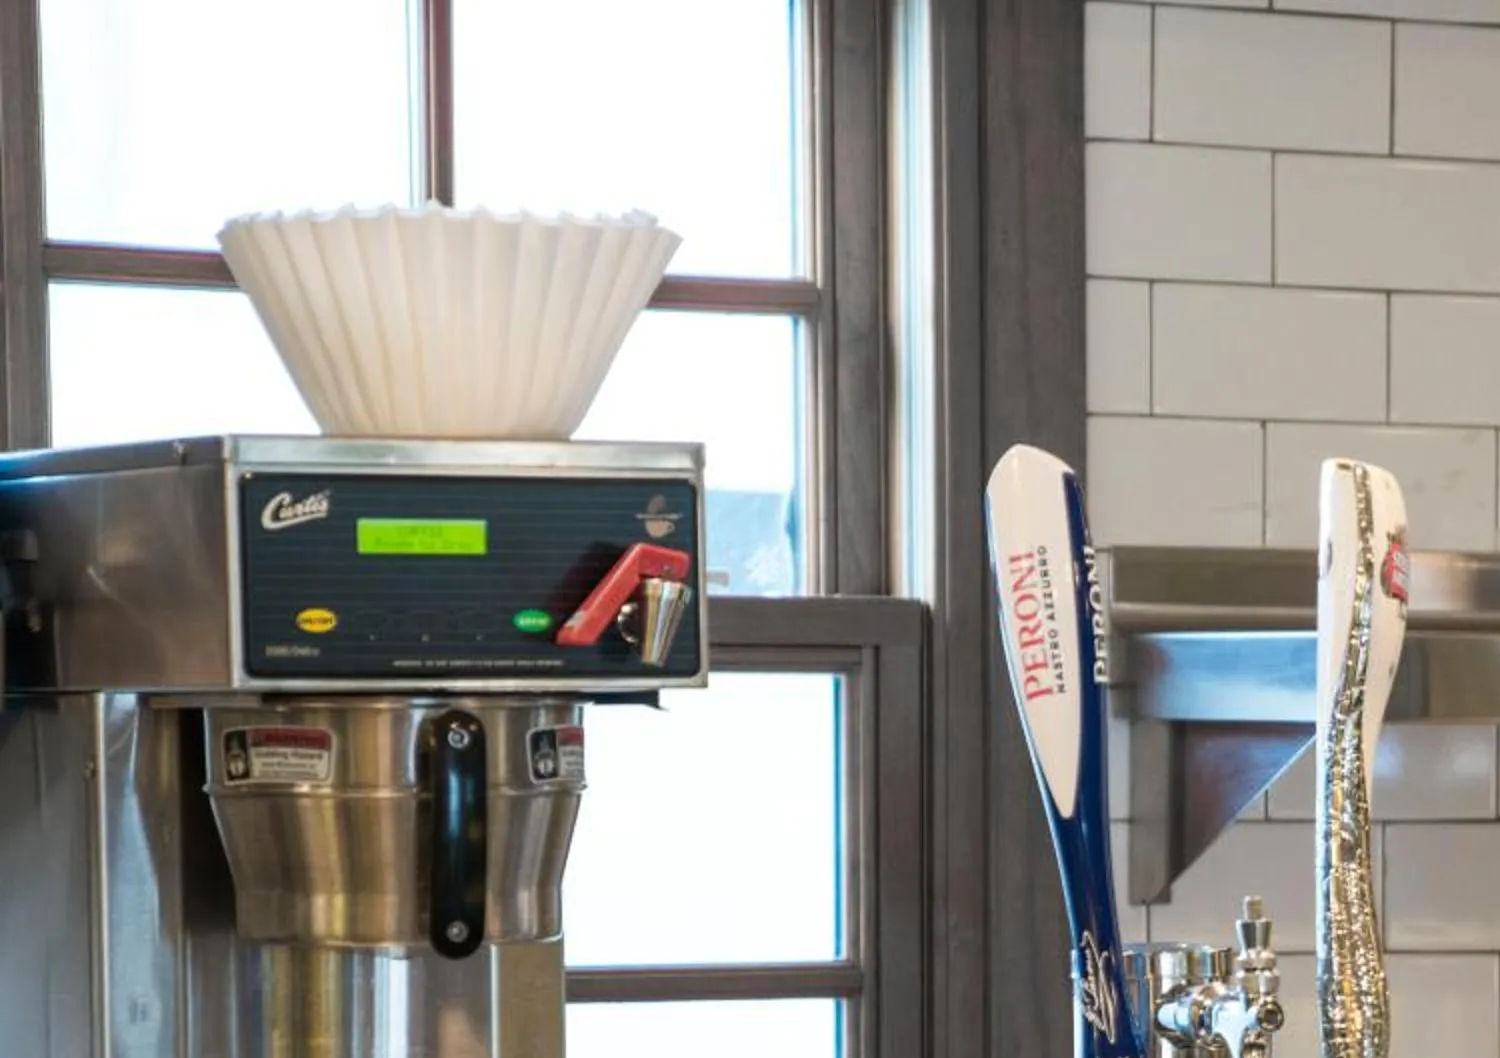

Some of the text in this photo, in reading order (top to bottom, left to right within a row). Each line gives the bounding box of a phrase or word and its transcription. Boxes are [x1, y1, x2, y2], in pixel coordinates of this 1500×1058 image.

[261, 491, 328, 530] Curtis
[1038, 546, 1056, 622] AZZURRO
[1009, 551, 1053, 701] PERONI
